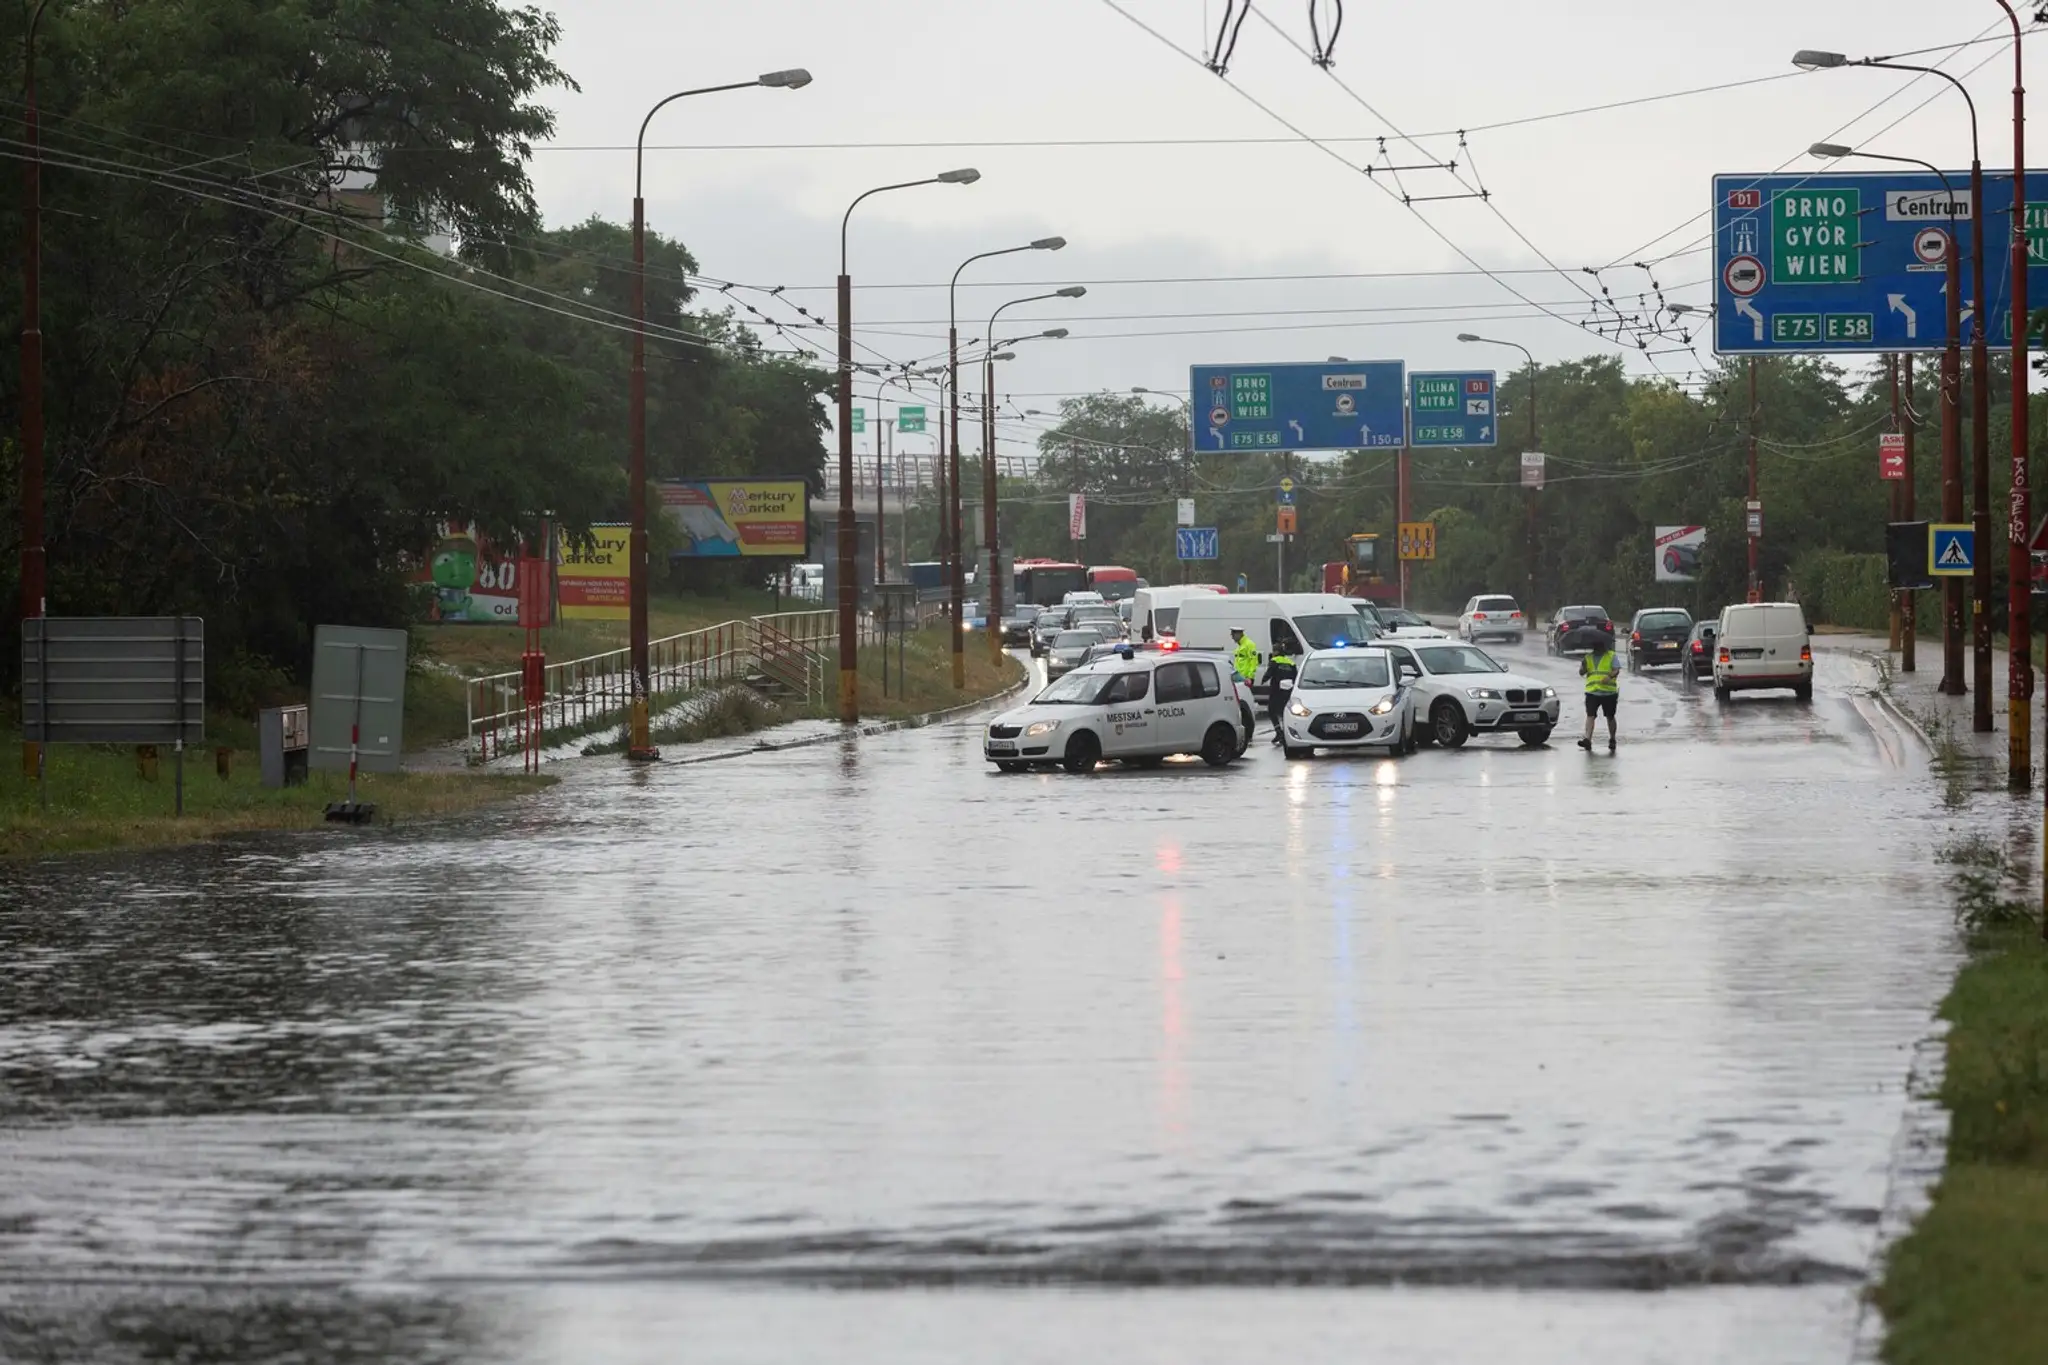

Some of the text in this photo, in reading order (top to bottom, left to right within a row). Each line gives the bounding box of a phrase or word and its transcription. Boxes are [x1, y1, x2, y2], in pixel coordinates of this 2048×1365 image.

[1738, 193, 1751, 205] D1
[1785, 198, 1846, 217] BRNO
[1897, 196, 1969, 216] Centrum
[1786, 220, 1846, 246] GYÖR
[1786, 255, 1846, 275] WIEN
[1236, 378, 1266, 388] BRNO
[1326, 377, 1363, 388] Centrum
[1419, 381, 1455, 393] ŽILINA
[1472, 382, 1483, 391] D1
[1237, 390, 1266, 402] GYÖR
[1420, 396, 1454, 407] NITRA
[1238, 406, 1267, 416] WIEN
[1372, 434, 1391, 444] 150
[727, 488, 795, 501] Merkury
[729, 502, 785, 515] Market
[493, 604, 511, 614] Od
[1106, 706, 1185, 722] MESTSKÁ POLÍCIA
